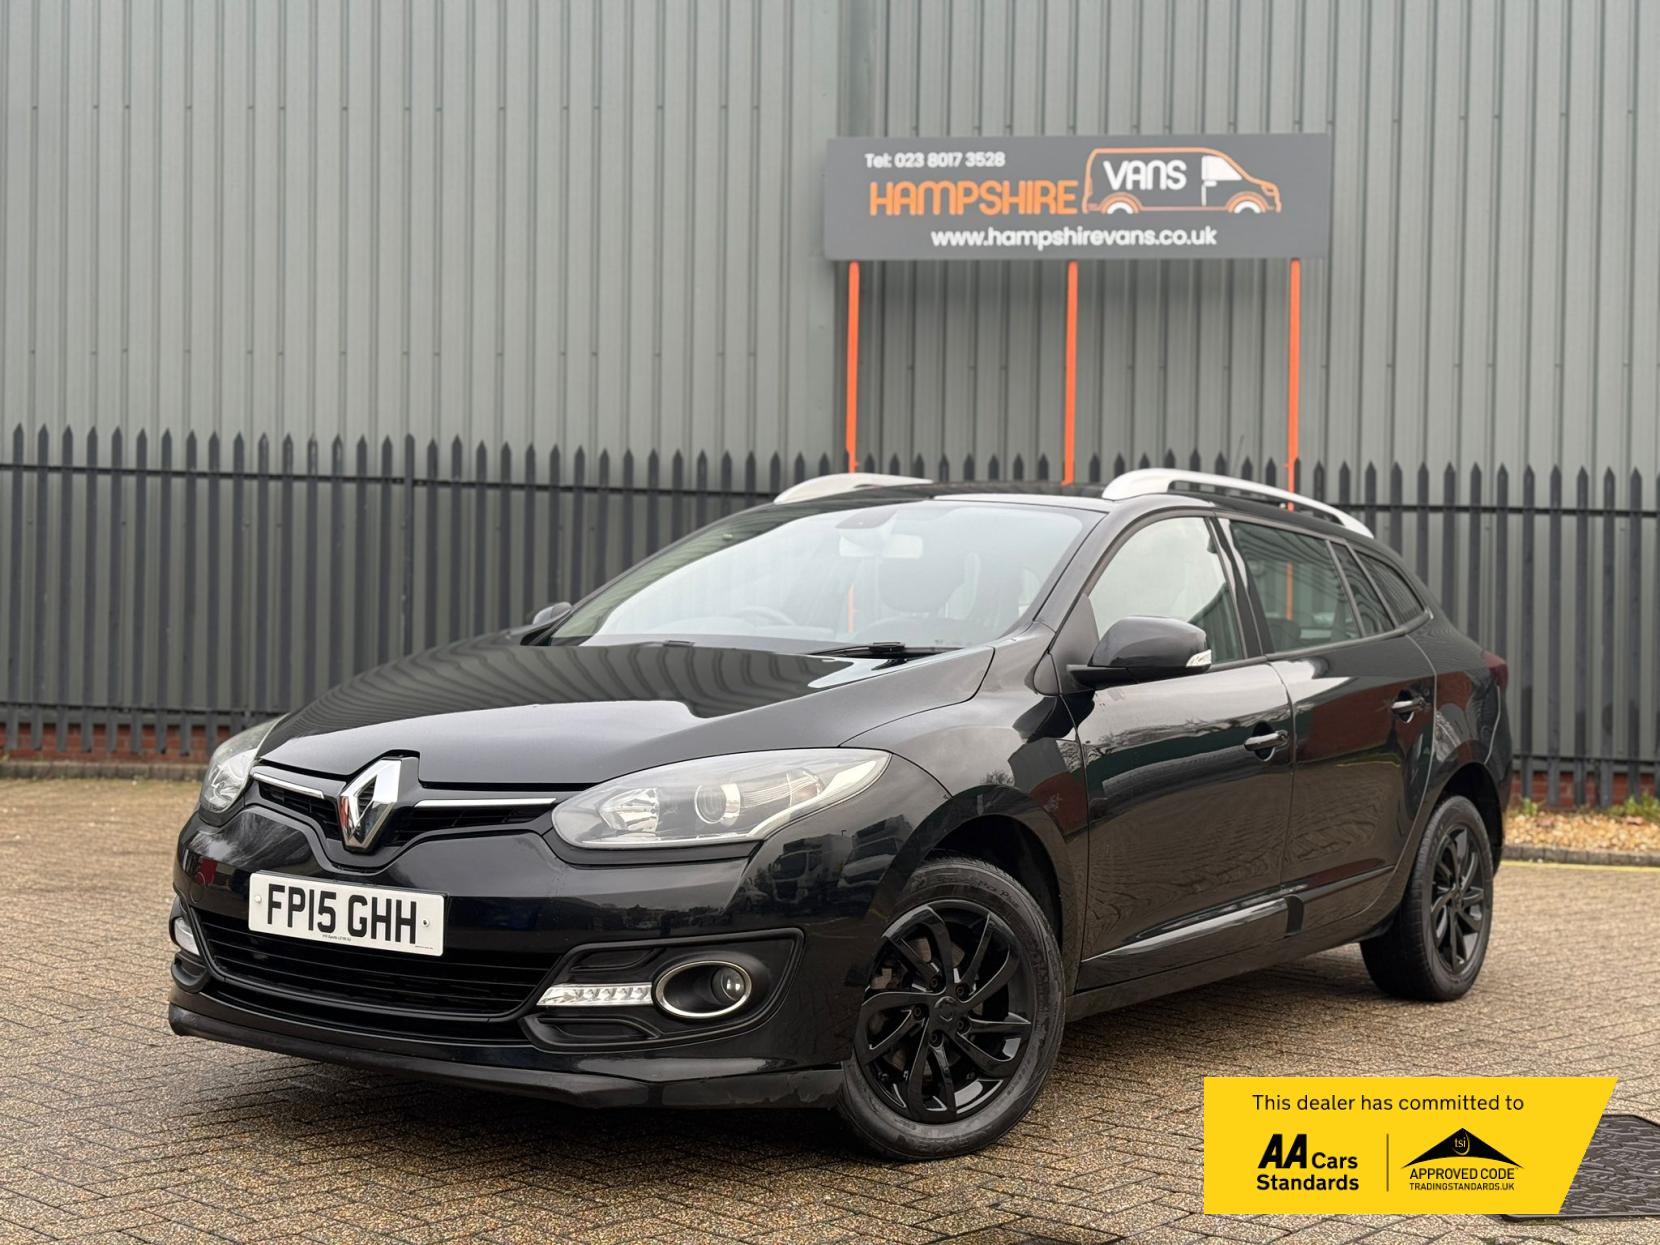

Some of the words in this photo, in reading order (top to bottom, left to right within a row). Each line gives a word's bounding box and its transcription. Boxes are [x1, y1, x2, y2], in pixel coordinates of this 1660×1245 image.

[865, 152, 892, 168] Tel:
[894, 153, 925, 168] 023
[927, 152, 963, 168] 8017
[965, 152, 1006, 168] 3528
[869, 179, 1078, 216] HAMPSHIRE
[1103, 159, 1188, 191] VANS
[930, 226, 1218, 251] www.hampshirevans.co.uk
[267, 883, 338, 934] FP15
[347, 894, 417, 945] GHH
